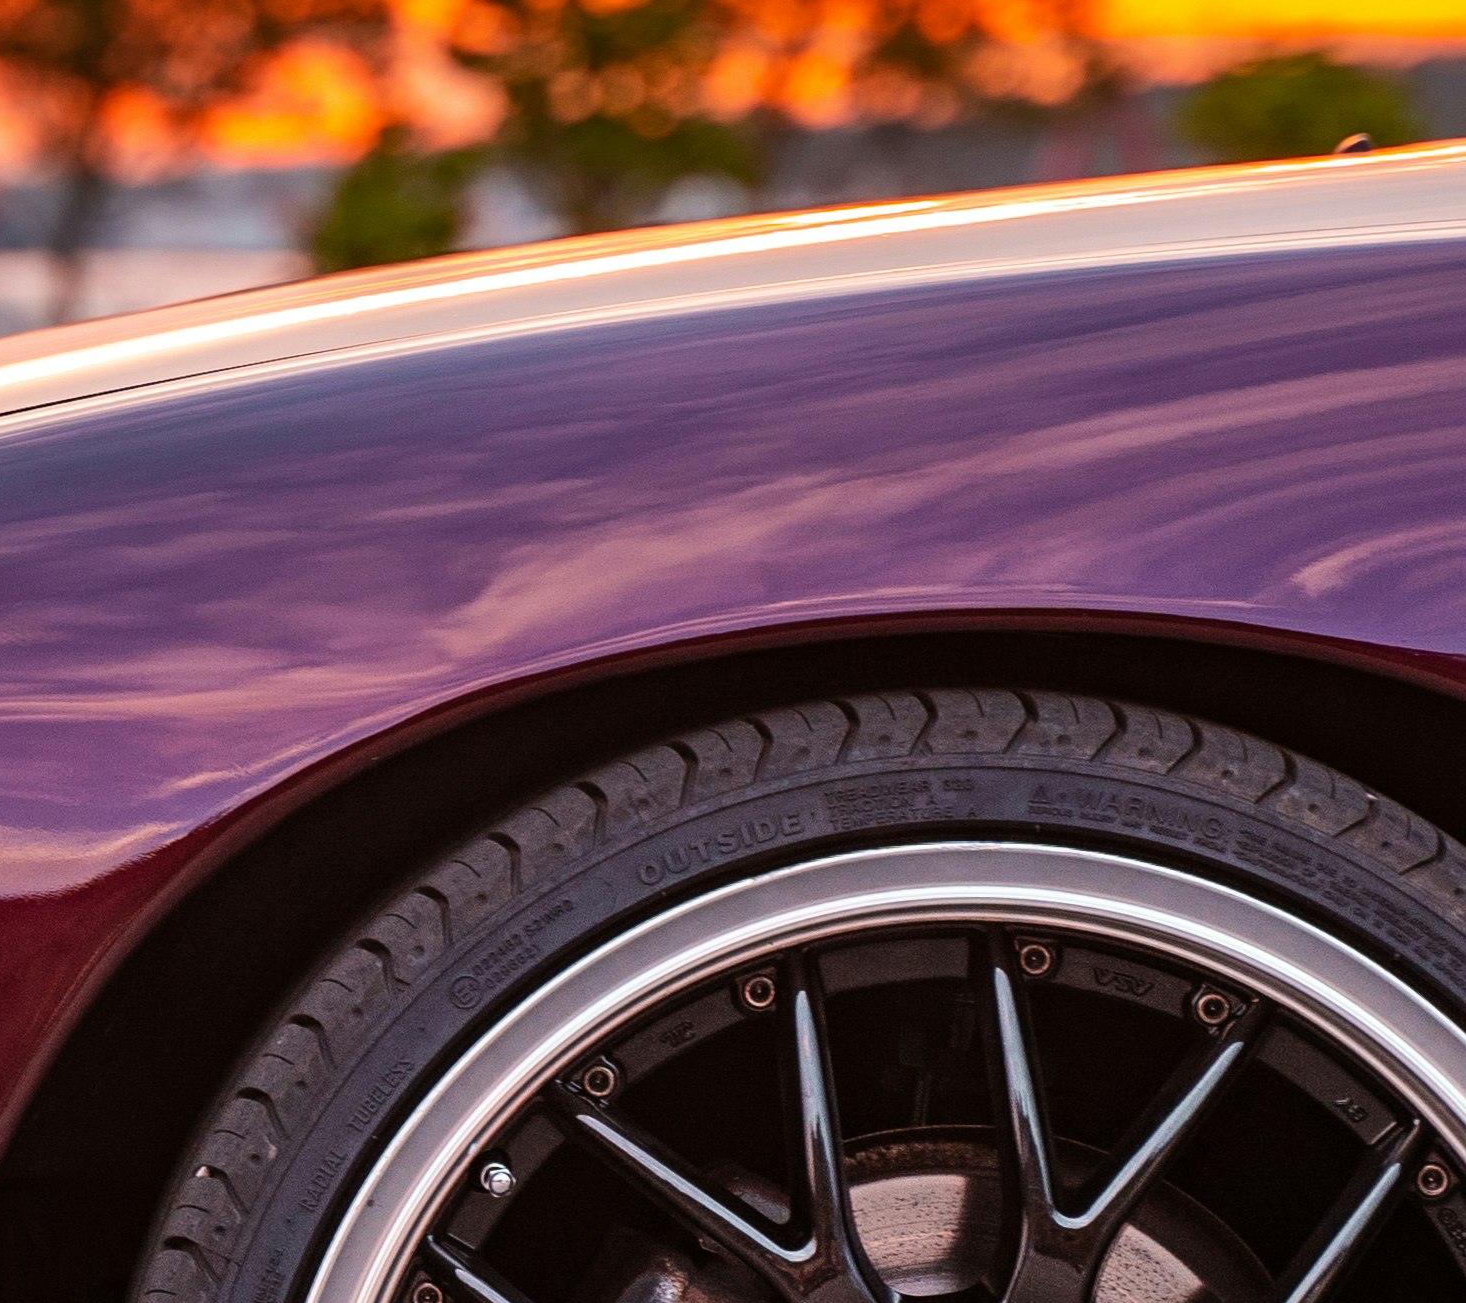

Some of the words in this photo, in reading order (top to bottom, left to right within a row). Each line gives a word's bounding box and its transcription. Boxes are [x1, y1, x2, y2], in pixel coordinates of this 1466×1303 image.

[633, 807, 804, 890] OUTSIDE
[1089, 966, 1155, 999] ASA
[297, 1145, 347, 1213] RADIAL
[345, 1051, 415, 1135] TUBELESS
